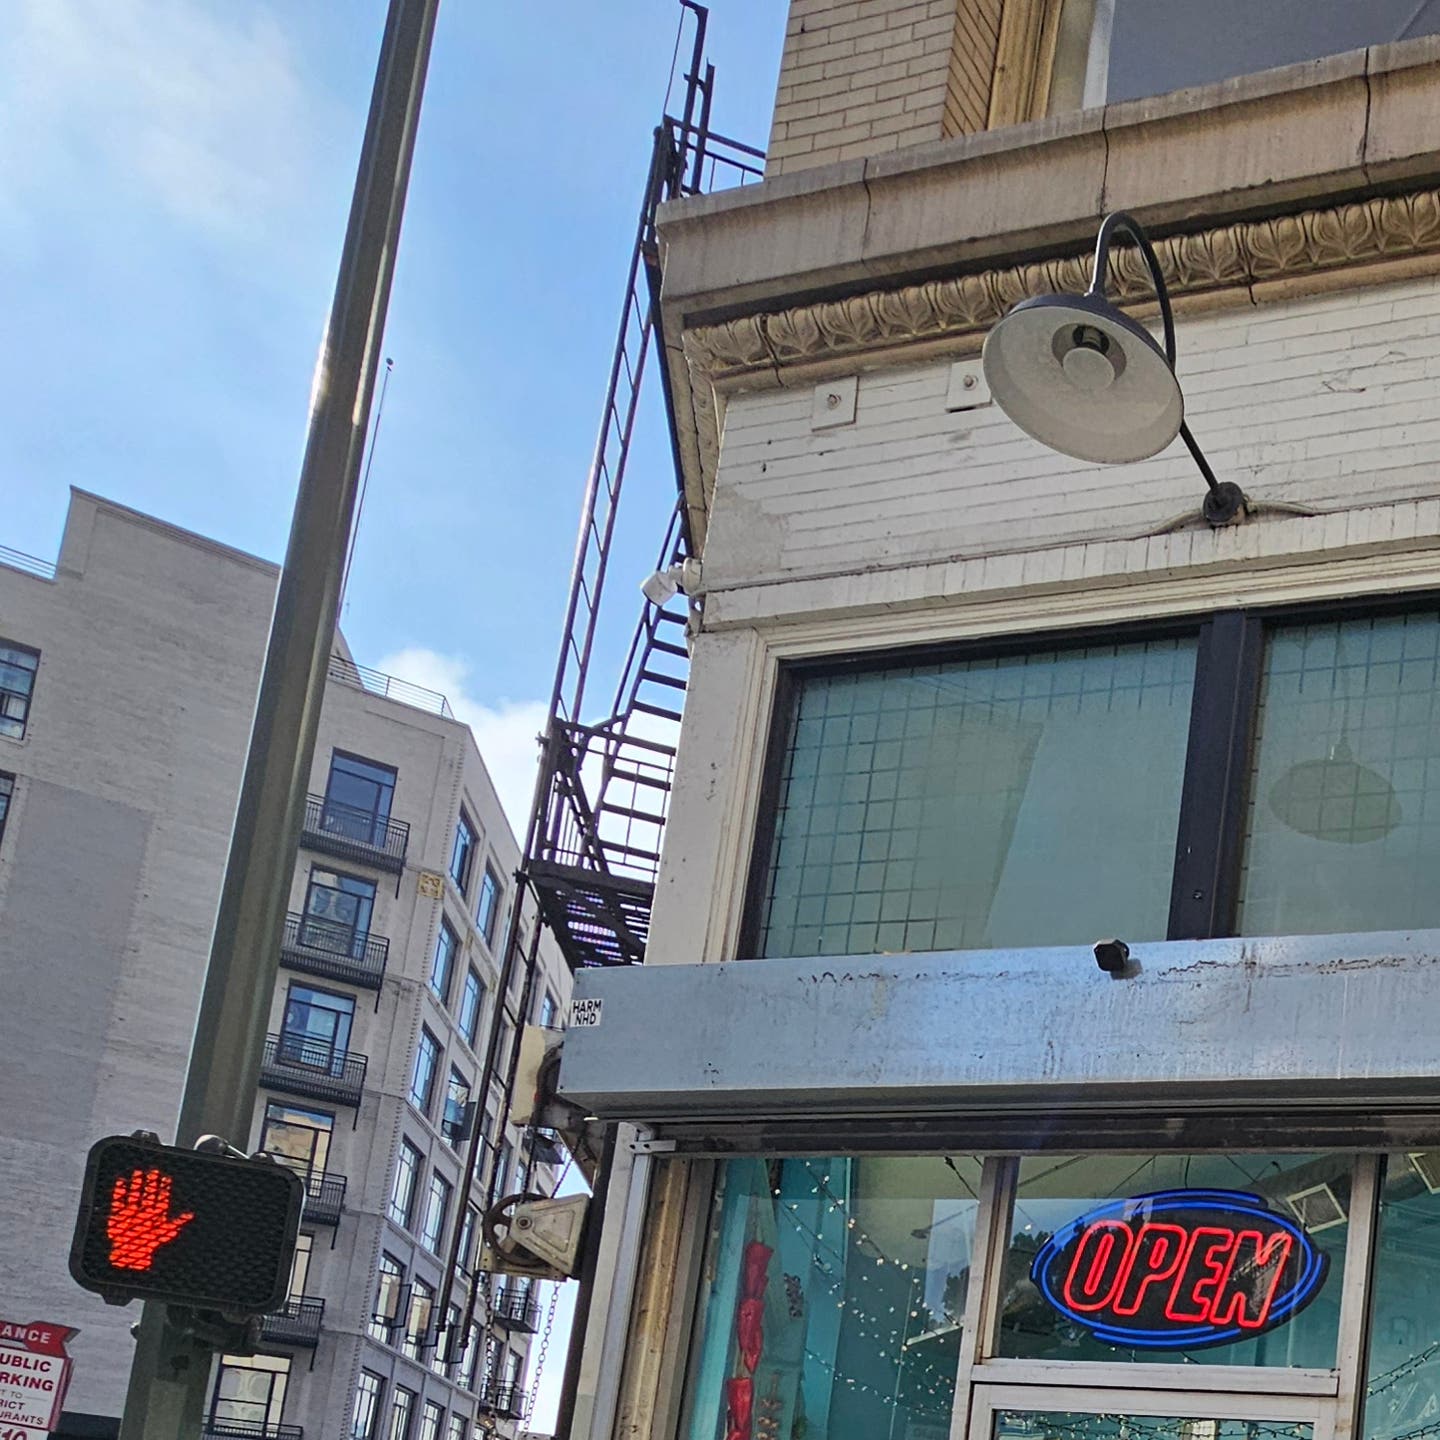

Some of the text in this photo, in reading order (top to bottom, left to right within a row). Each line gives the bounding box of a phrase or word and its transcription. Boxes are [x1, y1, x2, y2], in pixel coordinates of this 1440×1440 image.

[573, 1000, 601, 1013] HARM
[575, 1012, 597, 1025] NHD
[1063, 1219, 1292, 1329] OPEN
